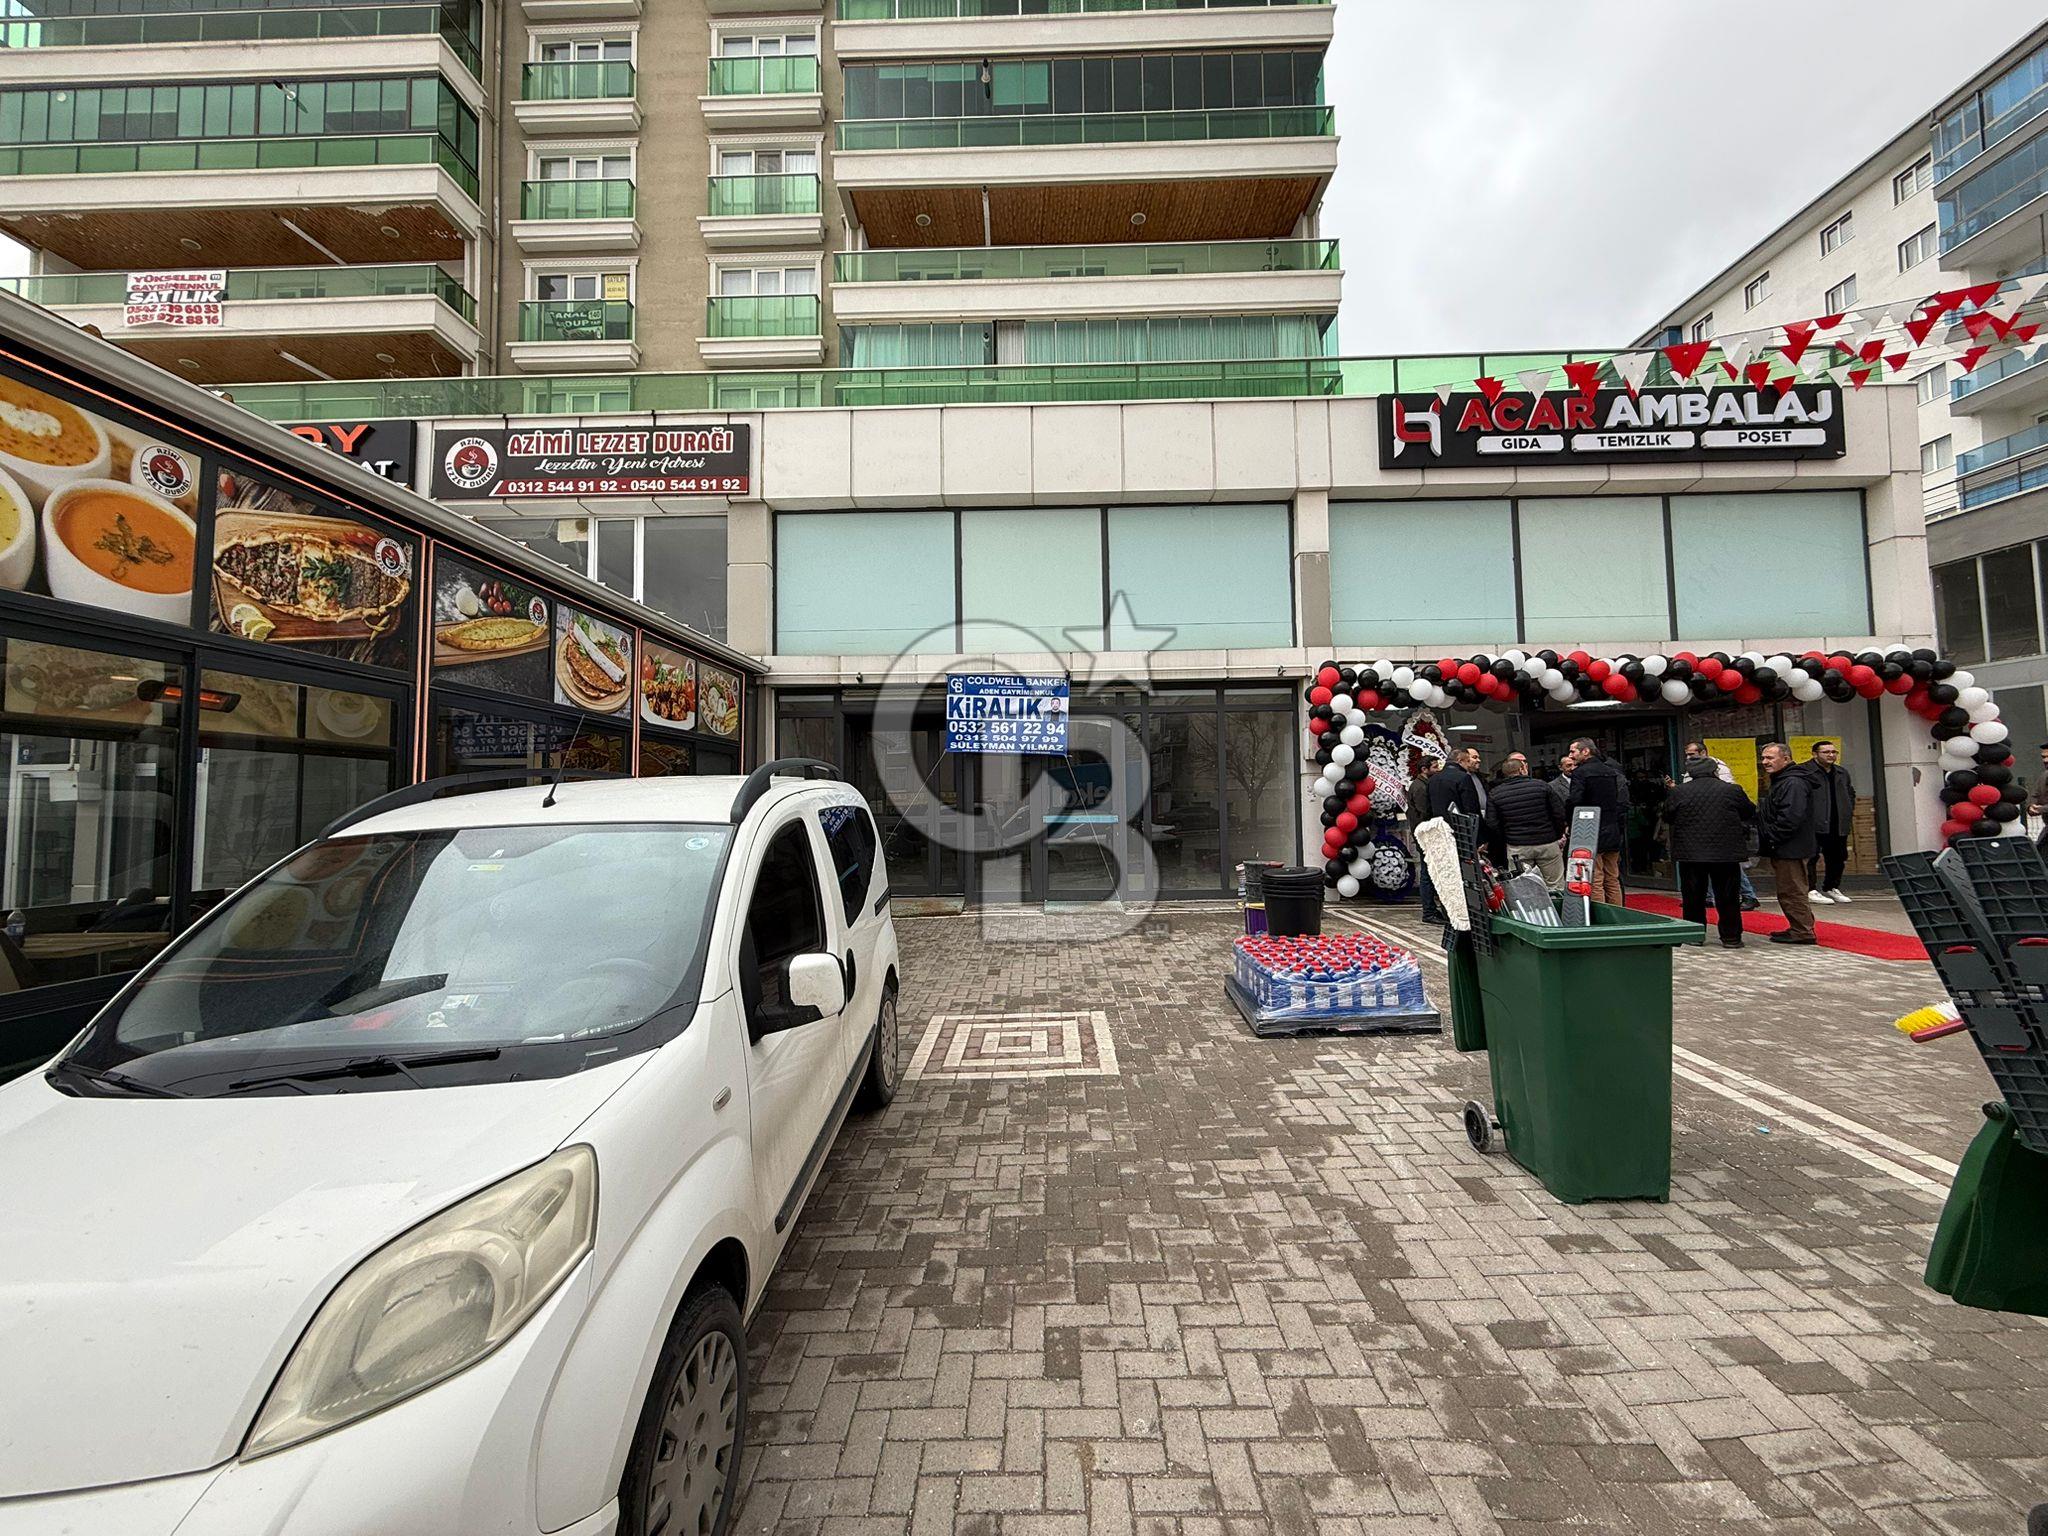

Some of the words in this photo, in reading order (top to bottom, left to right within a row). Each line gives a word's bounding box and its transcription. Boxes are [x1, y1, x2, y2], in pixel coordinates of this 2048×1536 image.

[134, 274, 206, 283] YÜKSELEN
[131, 283, 221, 291] GAYRİMENKUL
[128, 290, 220, 304] SATILIK
[185, 305, 202, 314] 60
[204, 305, 219, 314] 33
[205, 316, 219, 324] 16
[1456, 398, 1596, 432] ACAR
[1604, 390, 1832, 428] AMBALAJ
[508, 430, 572, 457] AZİMİ
[577, 432, 649, 456] LEZZET
[653, 427, 733, 454] DURAĞI
[1501, 437, 1541, 449] GIDA
[1737, 431, 1792, 445] POŞET
[534, 458, 598, 474] Lezzetin
[601, 457, 647, 475] Yeni
[649, 456, 705, 474] Adresi
[446, 462, 467, 487] LEZZET
[508, 481, 544, 493] 0312
[548, 481, 574, 493] 544
[578, 481, 594, 492] 91
[600, 480, 618, 491] 92
[631, 480, 666, 491] 0540
[670, 479, 697, 490] 544
[700, 479, 717, 490] 91
[722, 479, 740, 490] 92
[966, 676, 1023, 687] COLDWELL
[1025, 678, 1068, 688] BANKER
[949, 721, 987, 733] 0532
[991, 722, 1017, 734] 561
[1023, 723, 1041, 735] 22
[1046, 723, 1065, 735] 94
[950, 741, 1015, 750] SÜLEYMAN
[1019, 743, 1064, 751] YILMAZ
